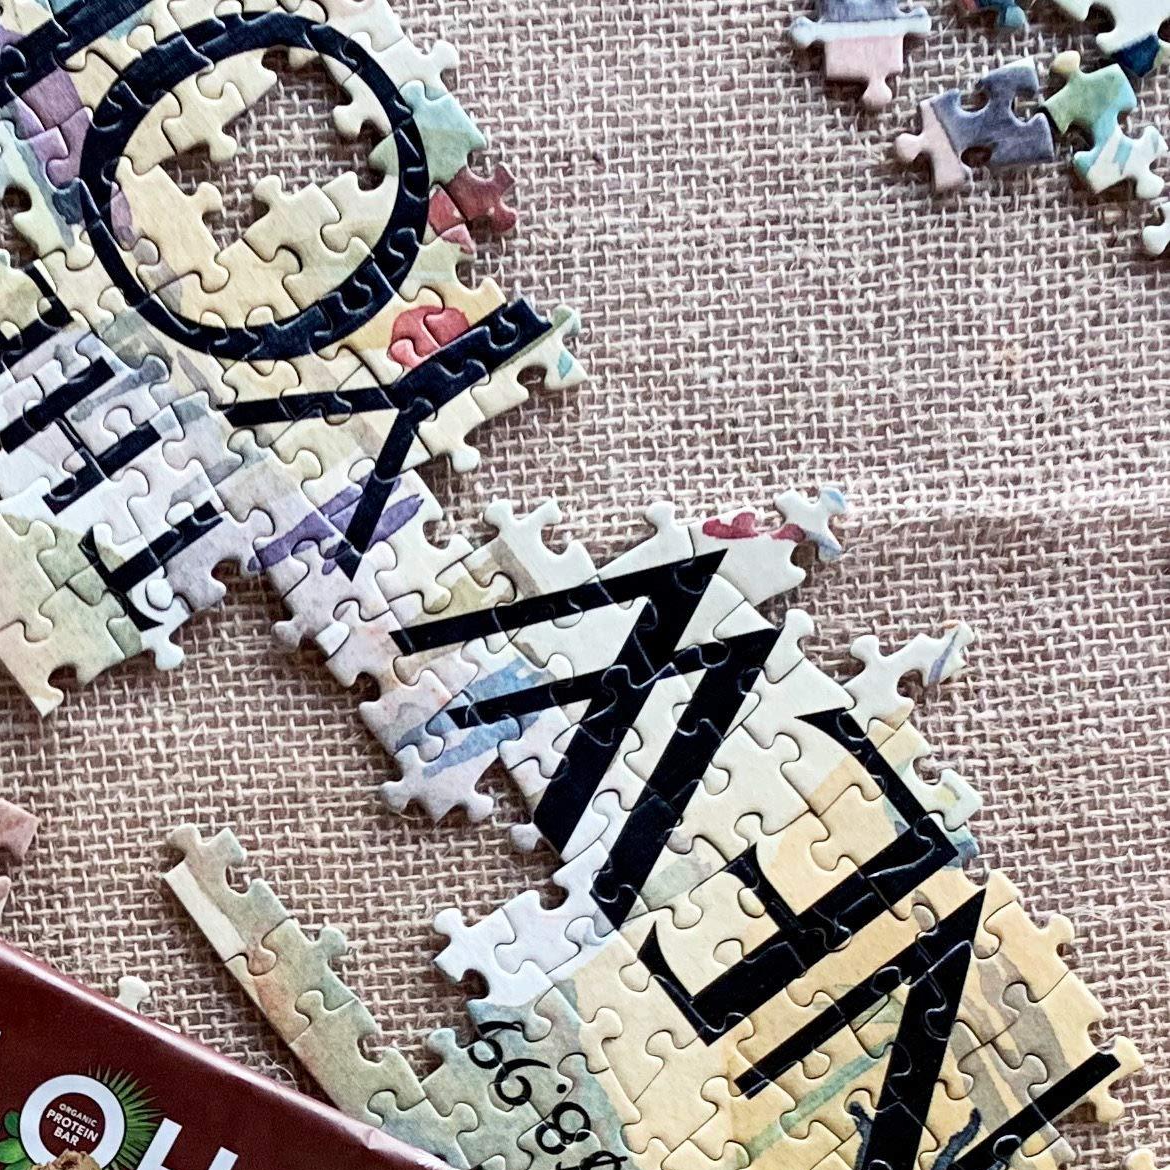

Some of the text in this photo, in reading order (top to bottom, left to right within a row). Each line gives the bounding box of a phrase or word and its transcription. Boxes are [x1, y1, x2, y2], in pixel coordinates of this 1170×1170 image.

[46, 1109, 99, 1143] PROTEIN
[59, 1103, 98, 1127] ORGANIC
[53, 1126, 80, 1146] BAR
